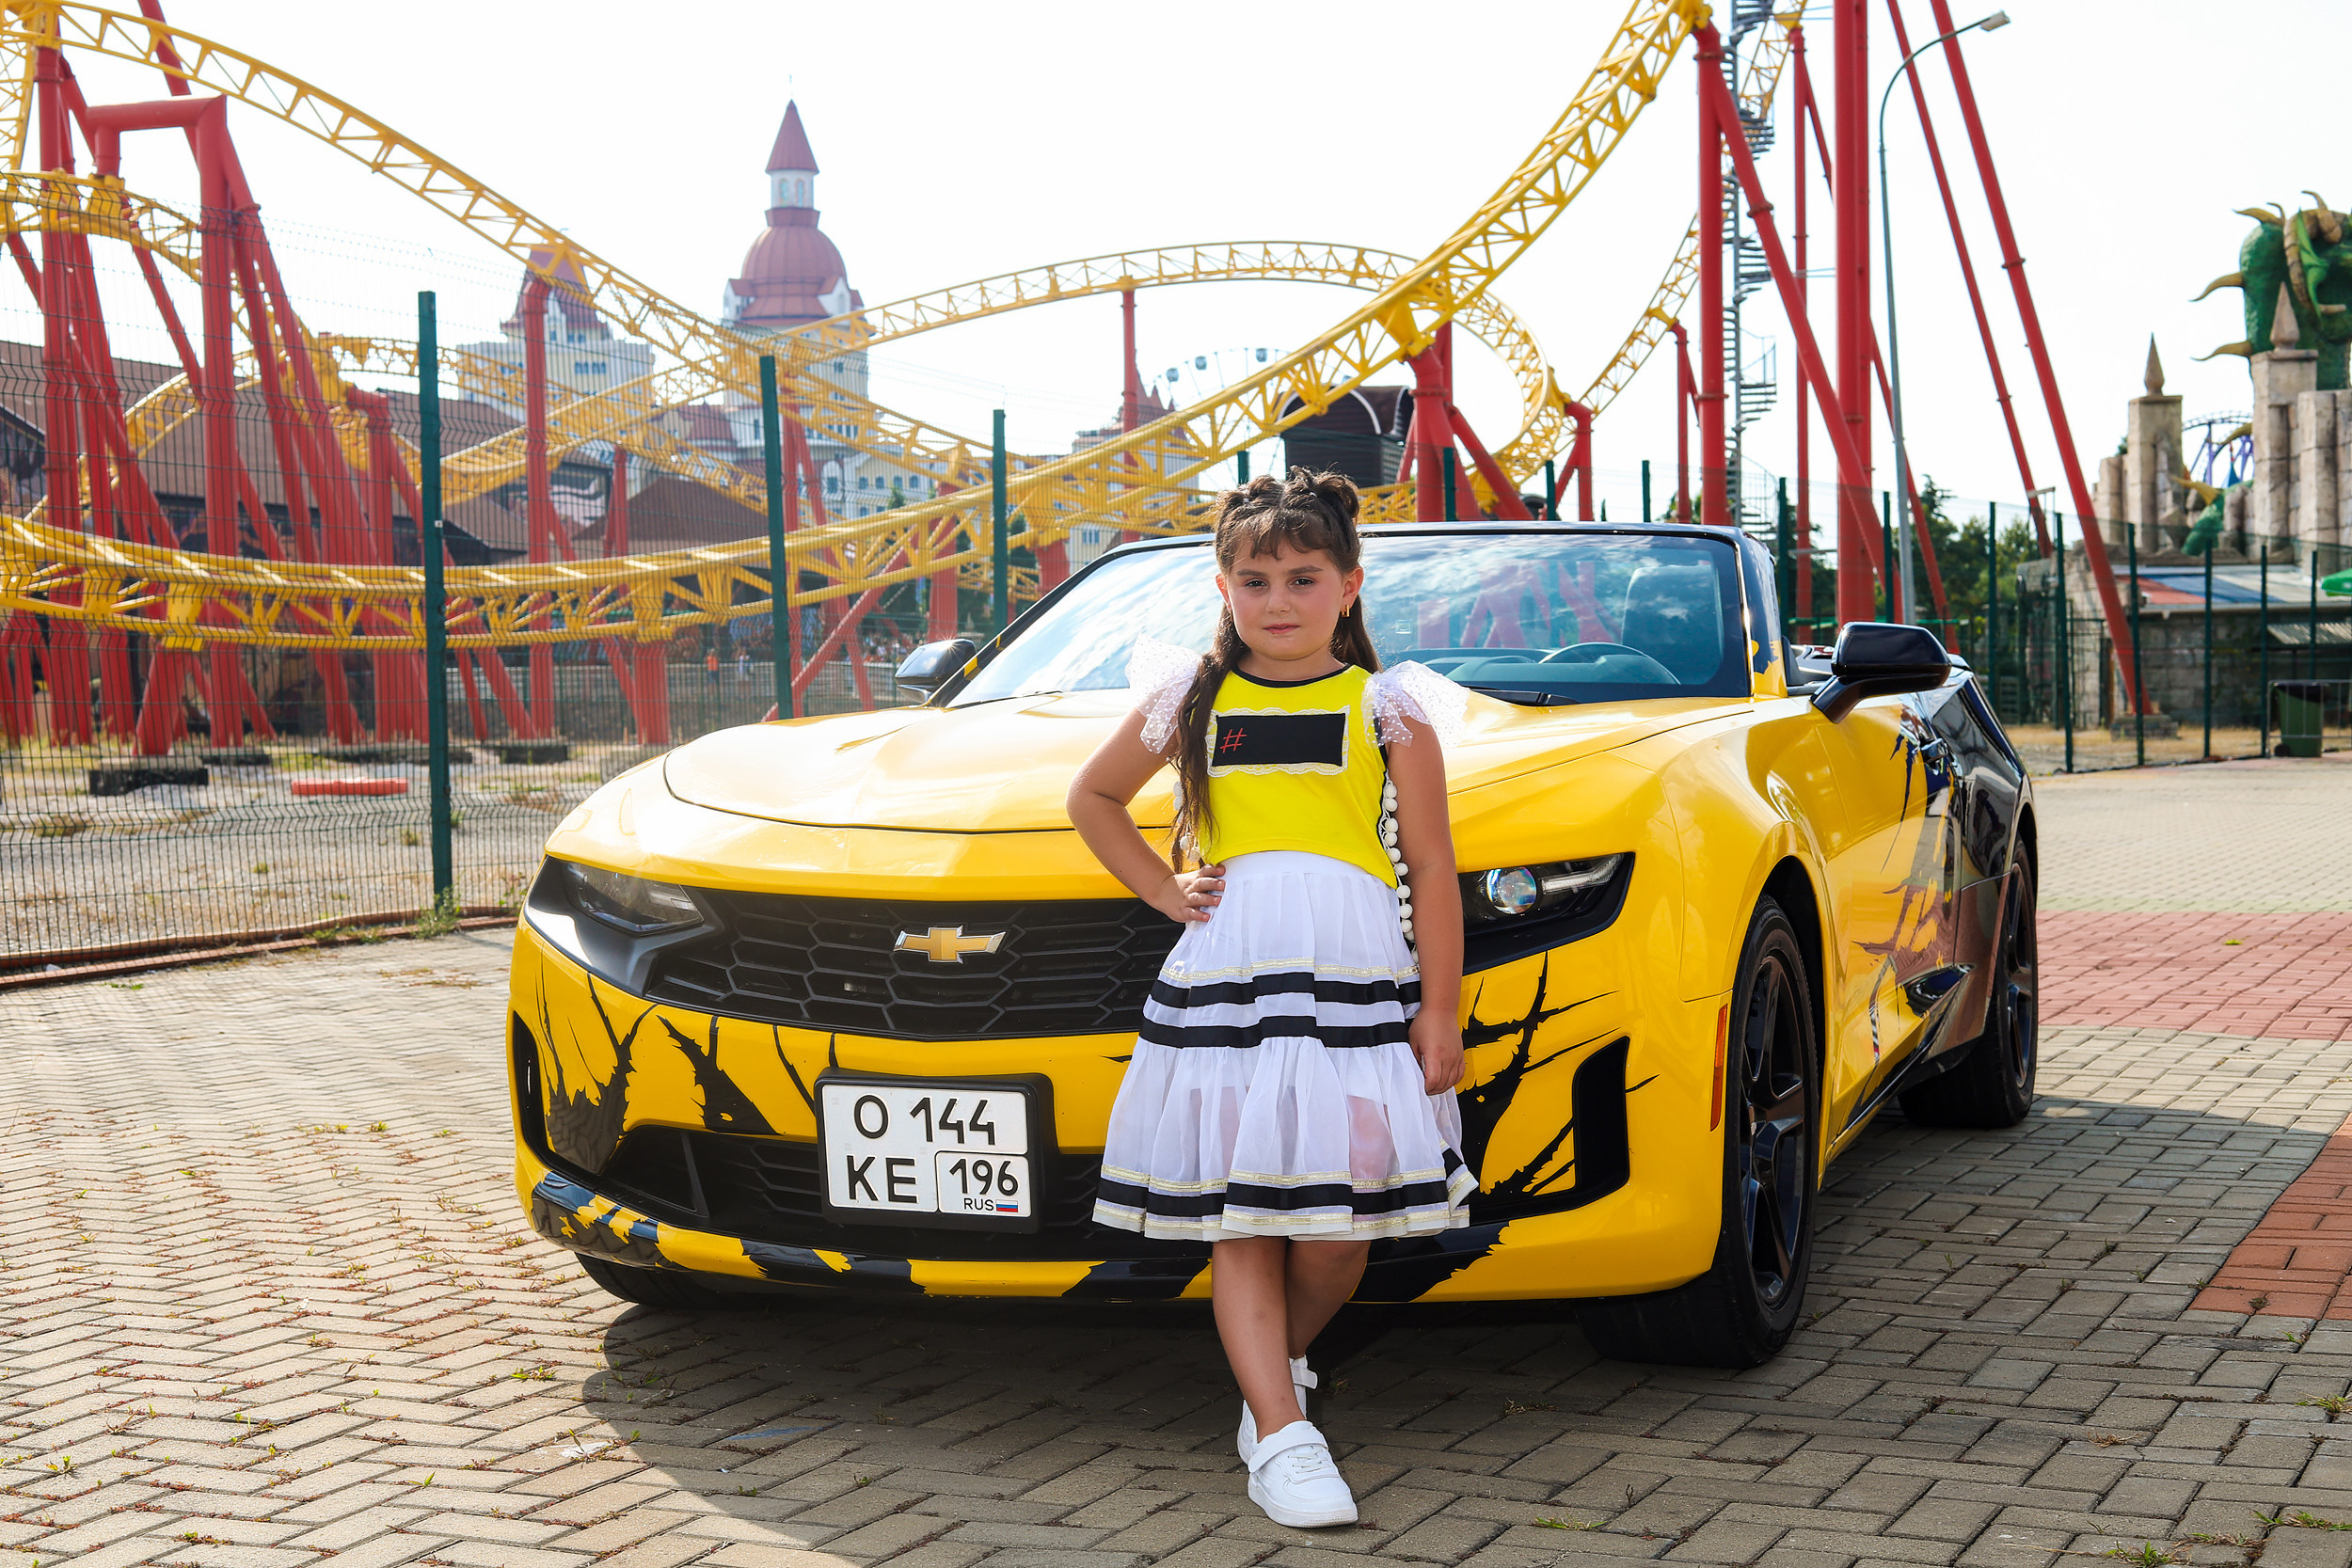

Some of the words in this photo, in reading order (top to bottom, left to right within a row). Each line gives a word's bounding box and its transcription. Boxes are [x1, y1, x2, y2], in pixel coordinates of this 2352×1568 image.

[910, 1097, 995, 1146] 144
[847, 1155, 918, 1204] KE
[949, 1158, 1019, 1196] 196
[963, 1197, 994, 1212] RUS
